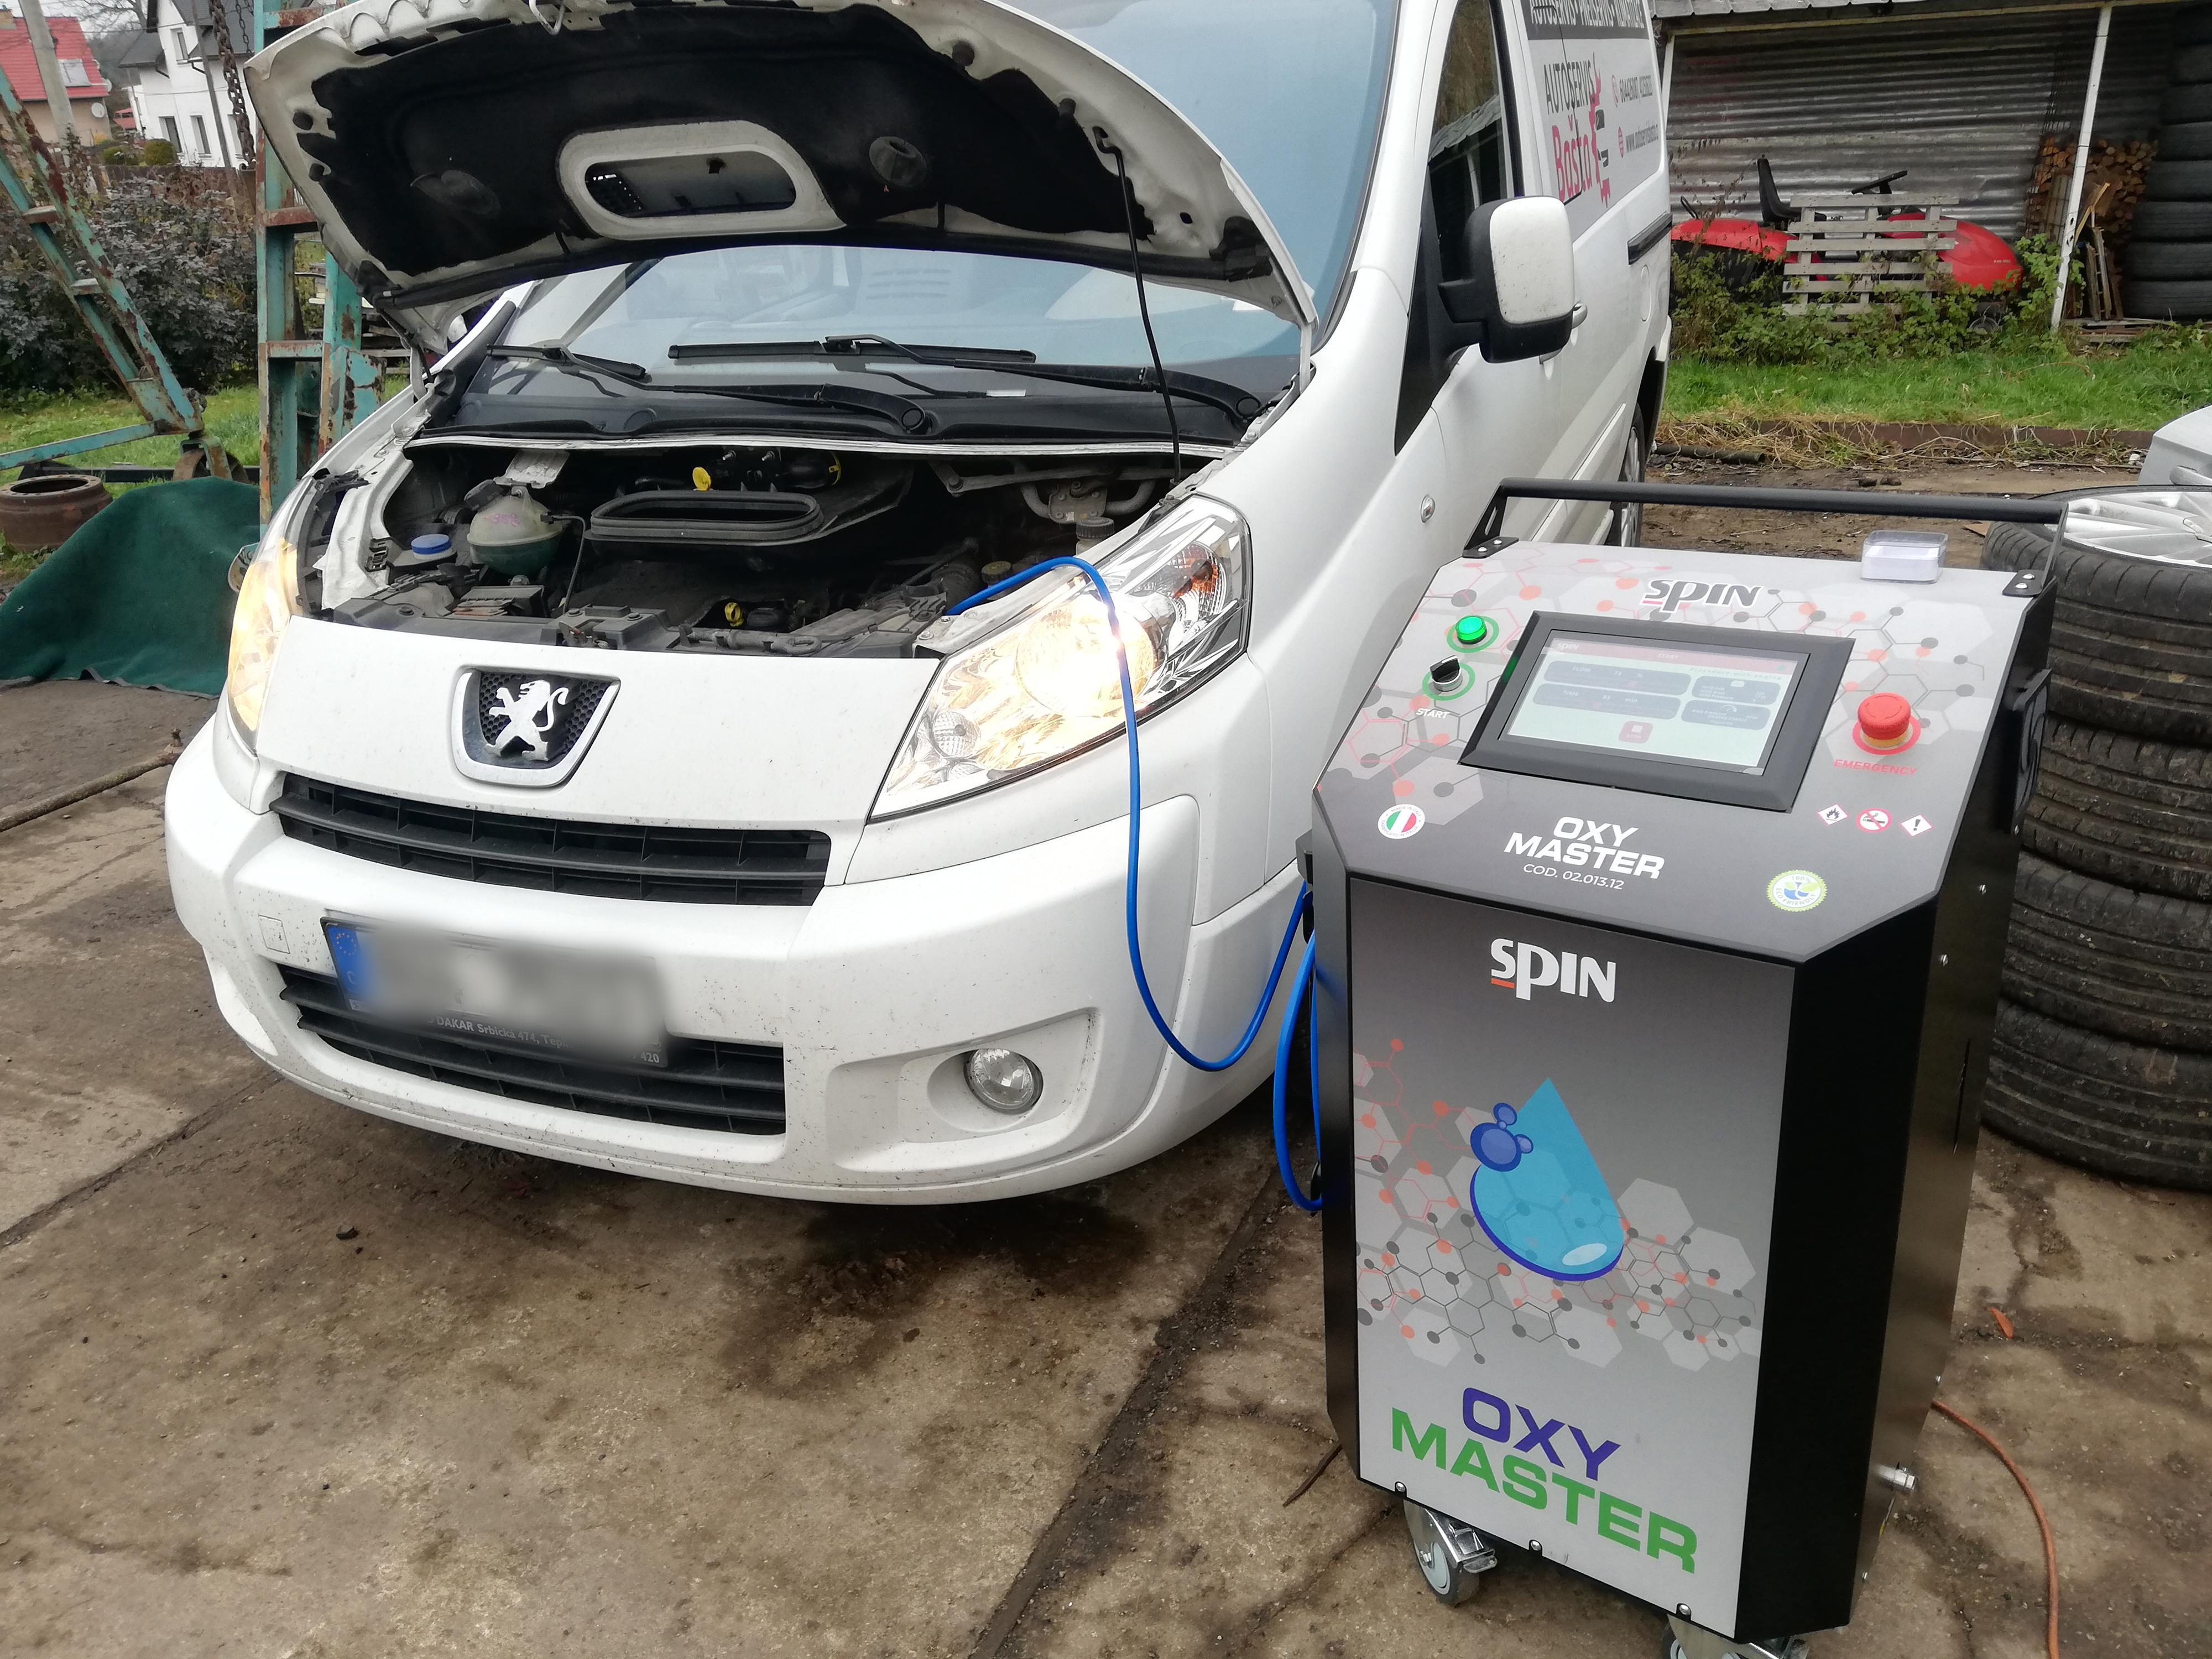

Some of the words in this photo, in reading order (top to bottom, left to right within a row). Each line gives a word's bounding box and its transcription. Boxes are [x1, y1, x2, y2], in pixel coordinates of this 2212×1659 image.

[1543, 60, 1597, 115] AUTOSERVIS
[1416, 708, 1450, 719] START
[1833, 759, 1918, 775] EMERGENCY
[1553, 816, 1639, 847] OXY
[1504, 832, 1665, 879] MASTER
[1523, 863, 1558, 878] COD.
[1562, 870, 1625, 890] 02.013.12
[436, 1016, 474, 1032] DAKAR
[477, 1023, 517, 1039] Srbická
[640, 1051, 660, 1063] 420
[1463, 1387, 1621, 1481] OXY
[1392, 1407, 1698, 1574] MASTER
